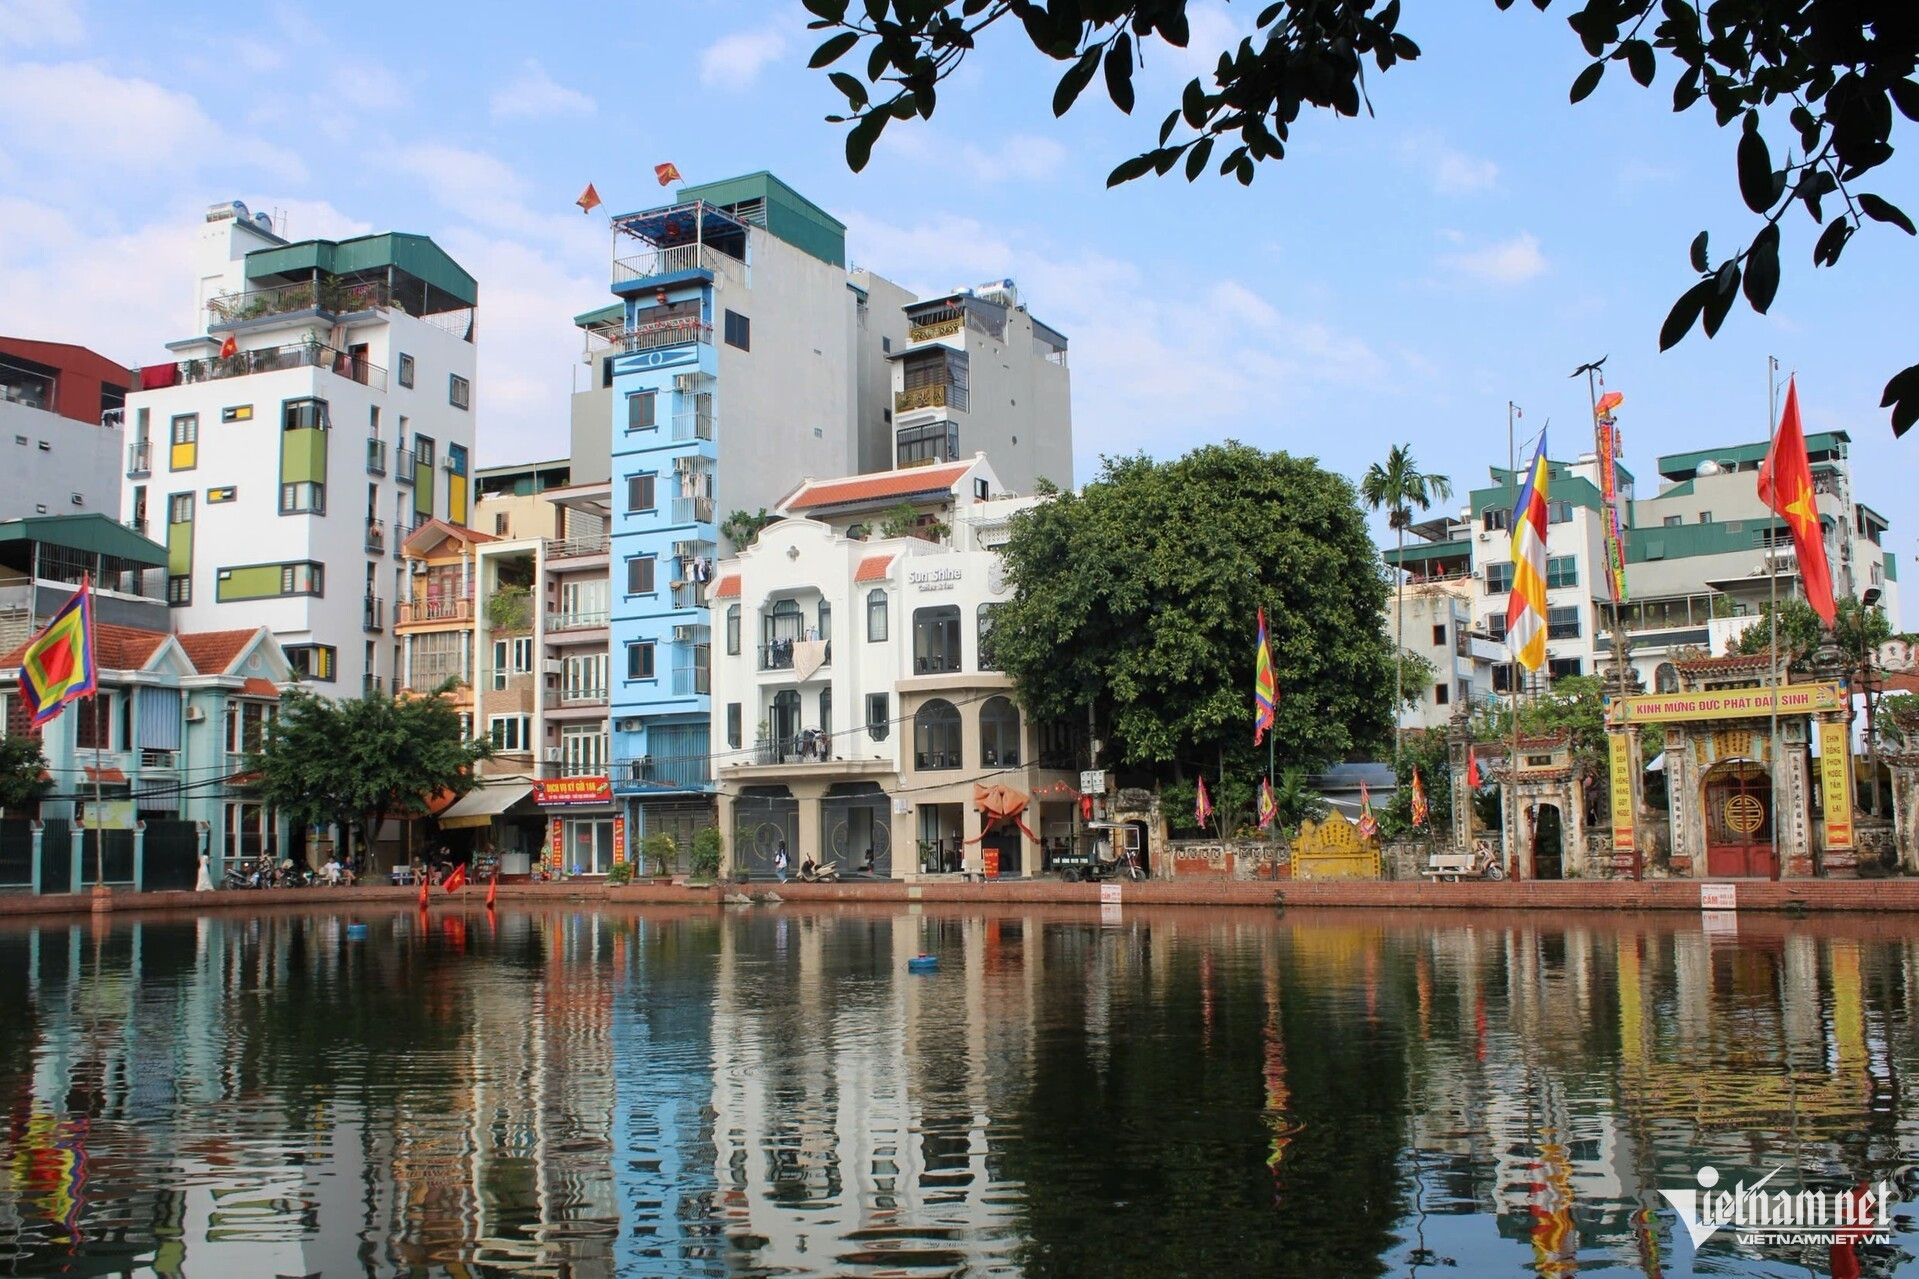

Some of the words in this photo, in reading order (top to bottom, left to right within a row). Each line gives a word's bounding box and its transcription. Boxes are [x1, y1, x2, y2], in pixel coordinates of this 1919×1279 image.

[909, 571, 928, 584] Sun
[932, 567, 962, 582] Shine
[1636, 702, 1661, 715] KÍNH
[1699, 698, 1720, 711] ĐỨC
[1724, 696, 1751, 711] PHẬT
[1781, 693, 1809, 706] SINH
